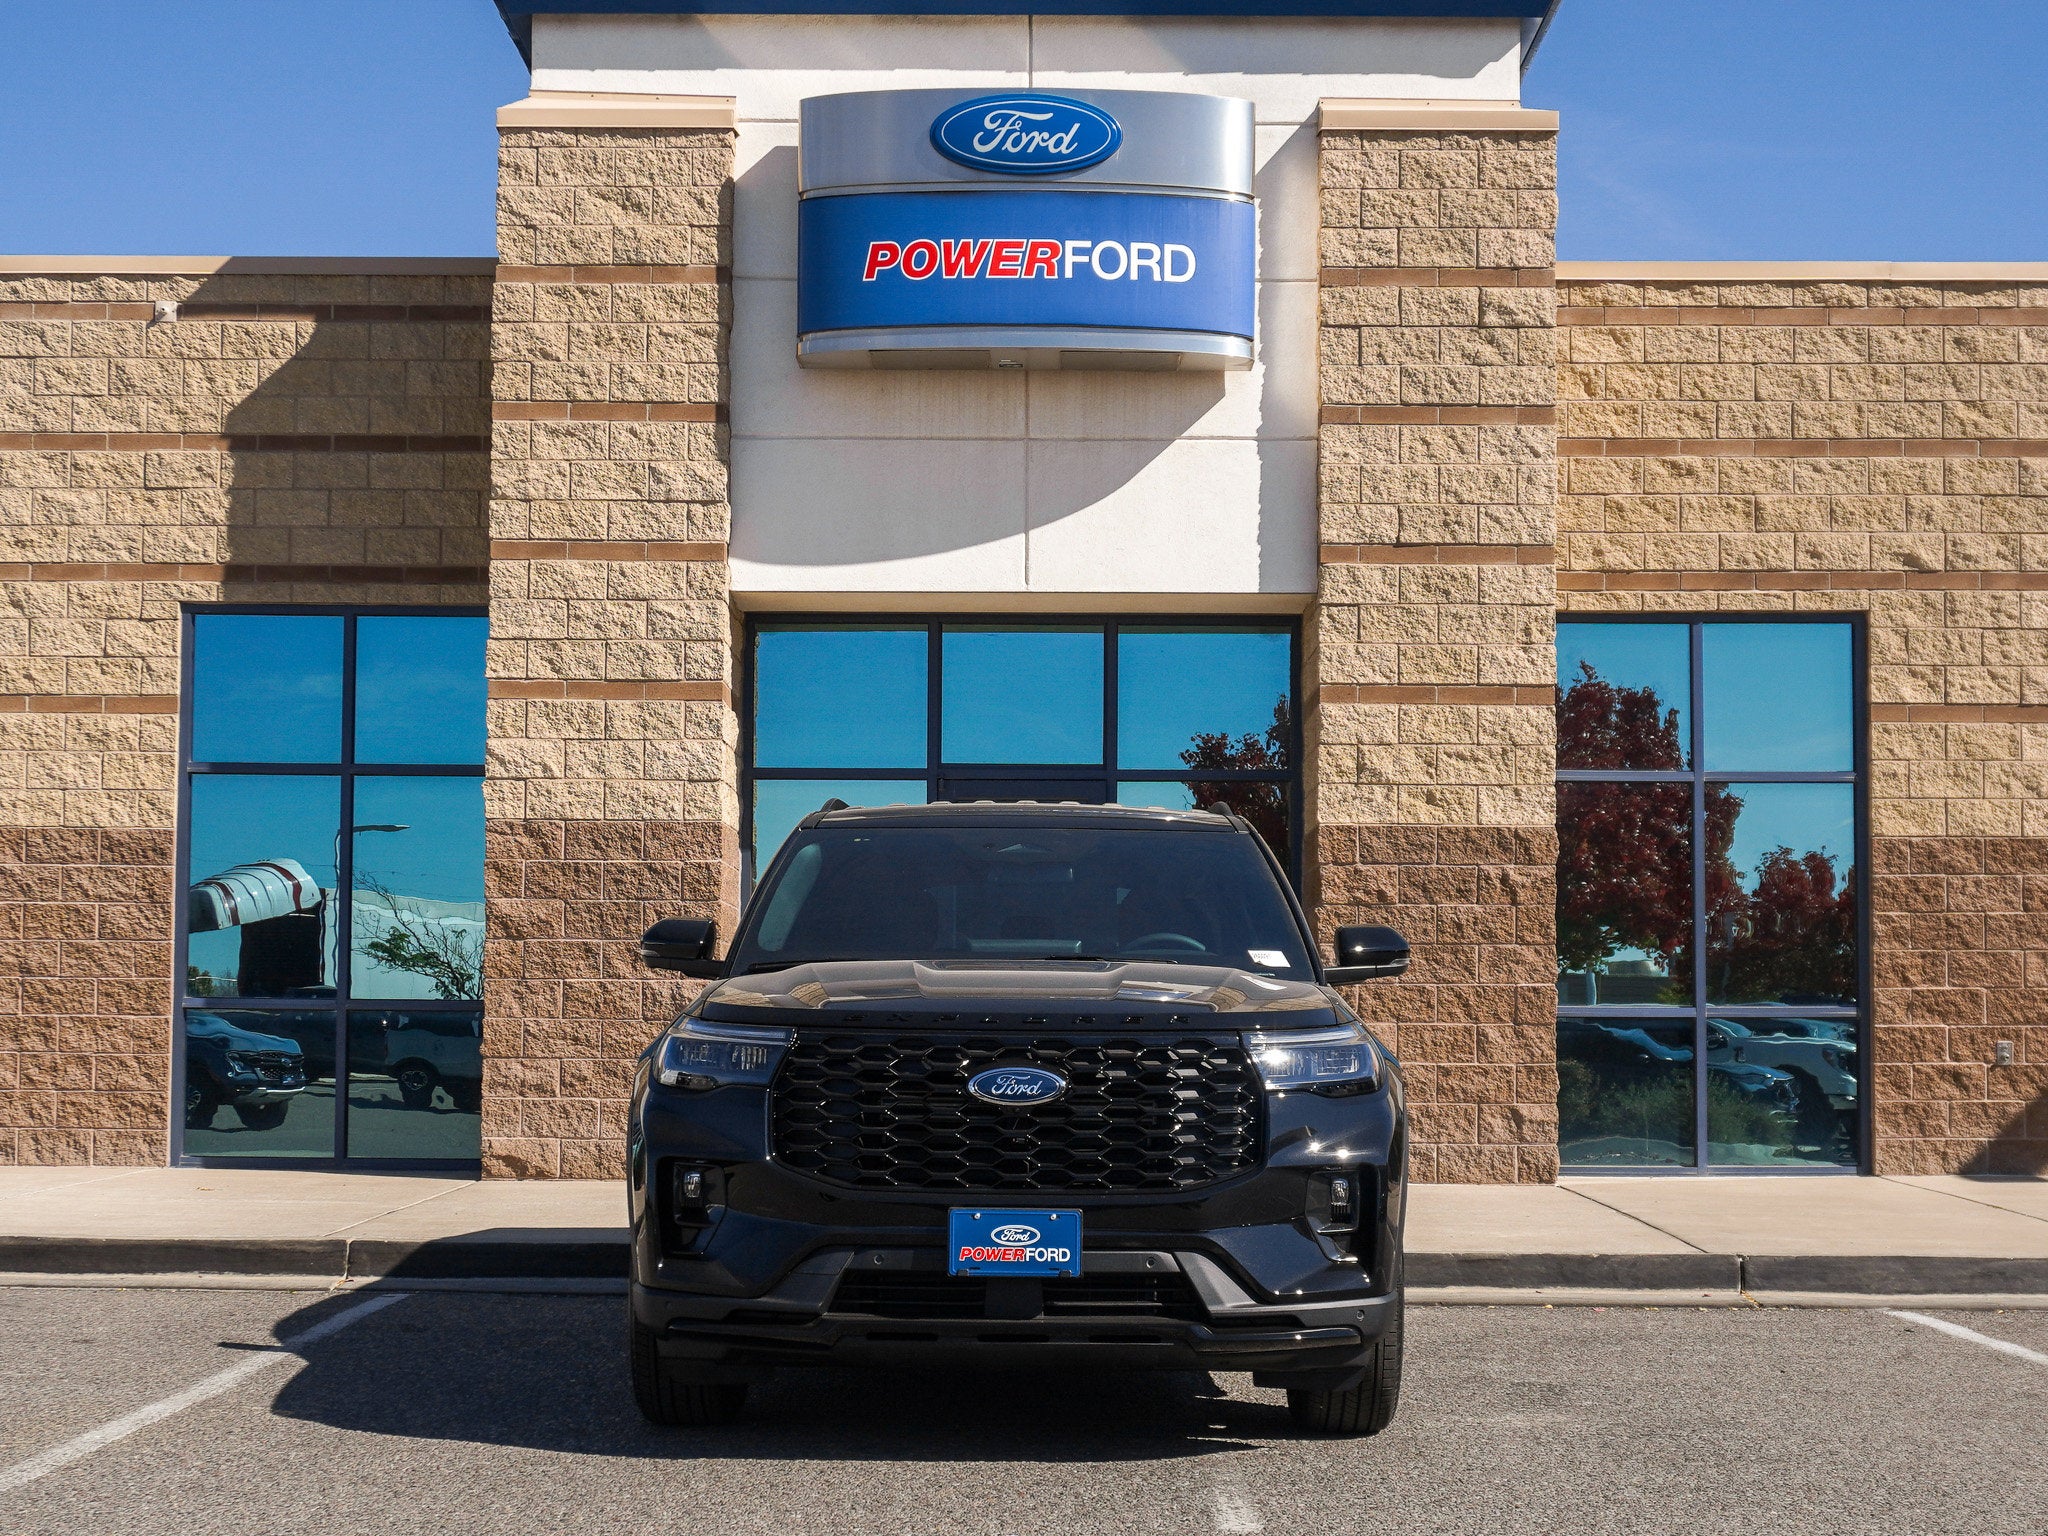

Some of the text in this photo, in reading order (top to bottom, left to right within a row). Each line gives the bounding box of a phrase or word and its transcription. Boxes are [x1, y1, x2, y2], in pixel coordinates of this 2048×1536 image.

[973, 109, 1078, 155] Ford
[862, 238, 1197, 283] POWERFORD
[991, 1074, 1043, 1096] Ford
[1000, 1228, 1030, 1242] Ford
[959, 1246, 1071, 1262] POWERFORD
